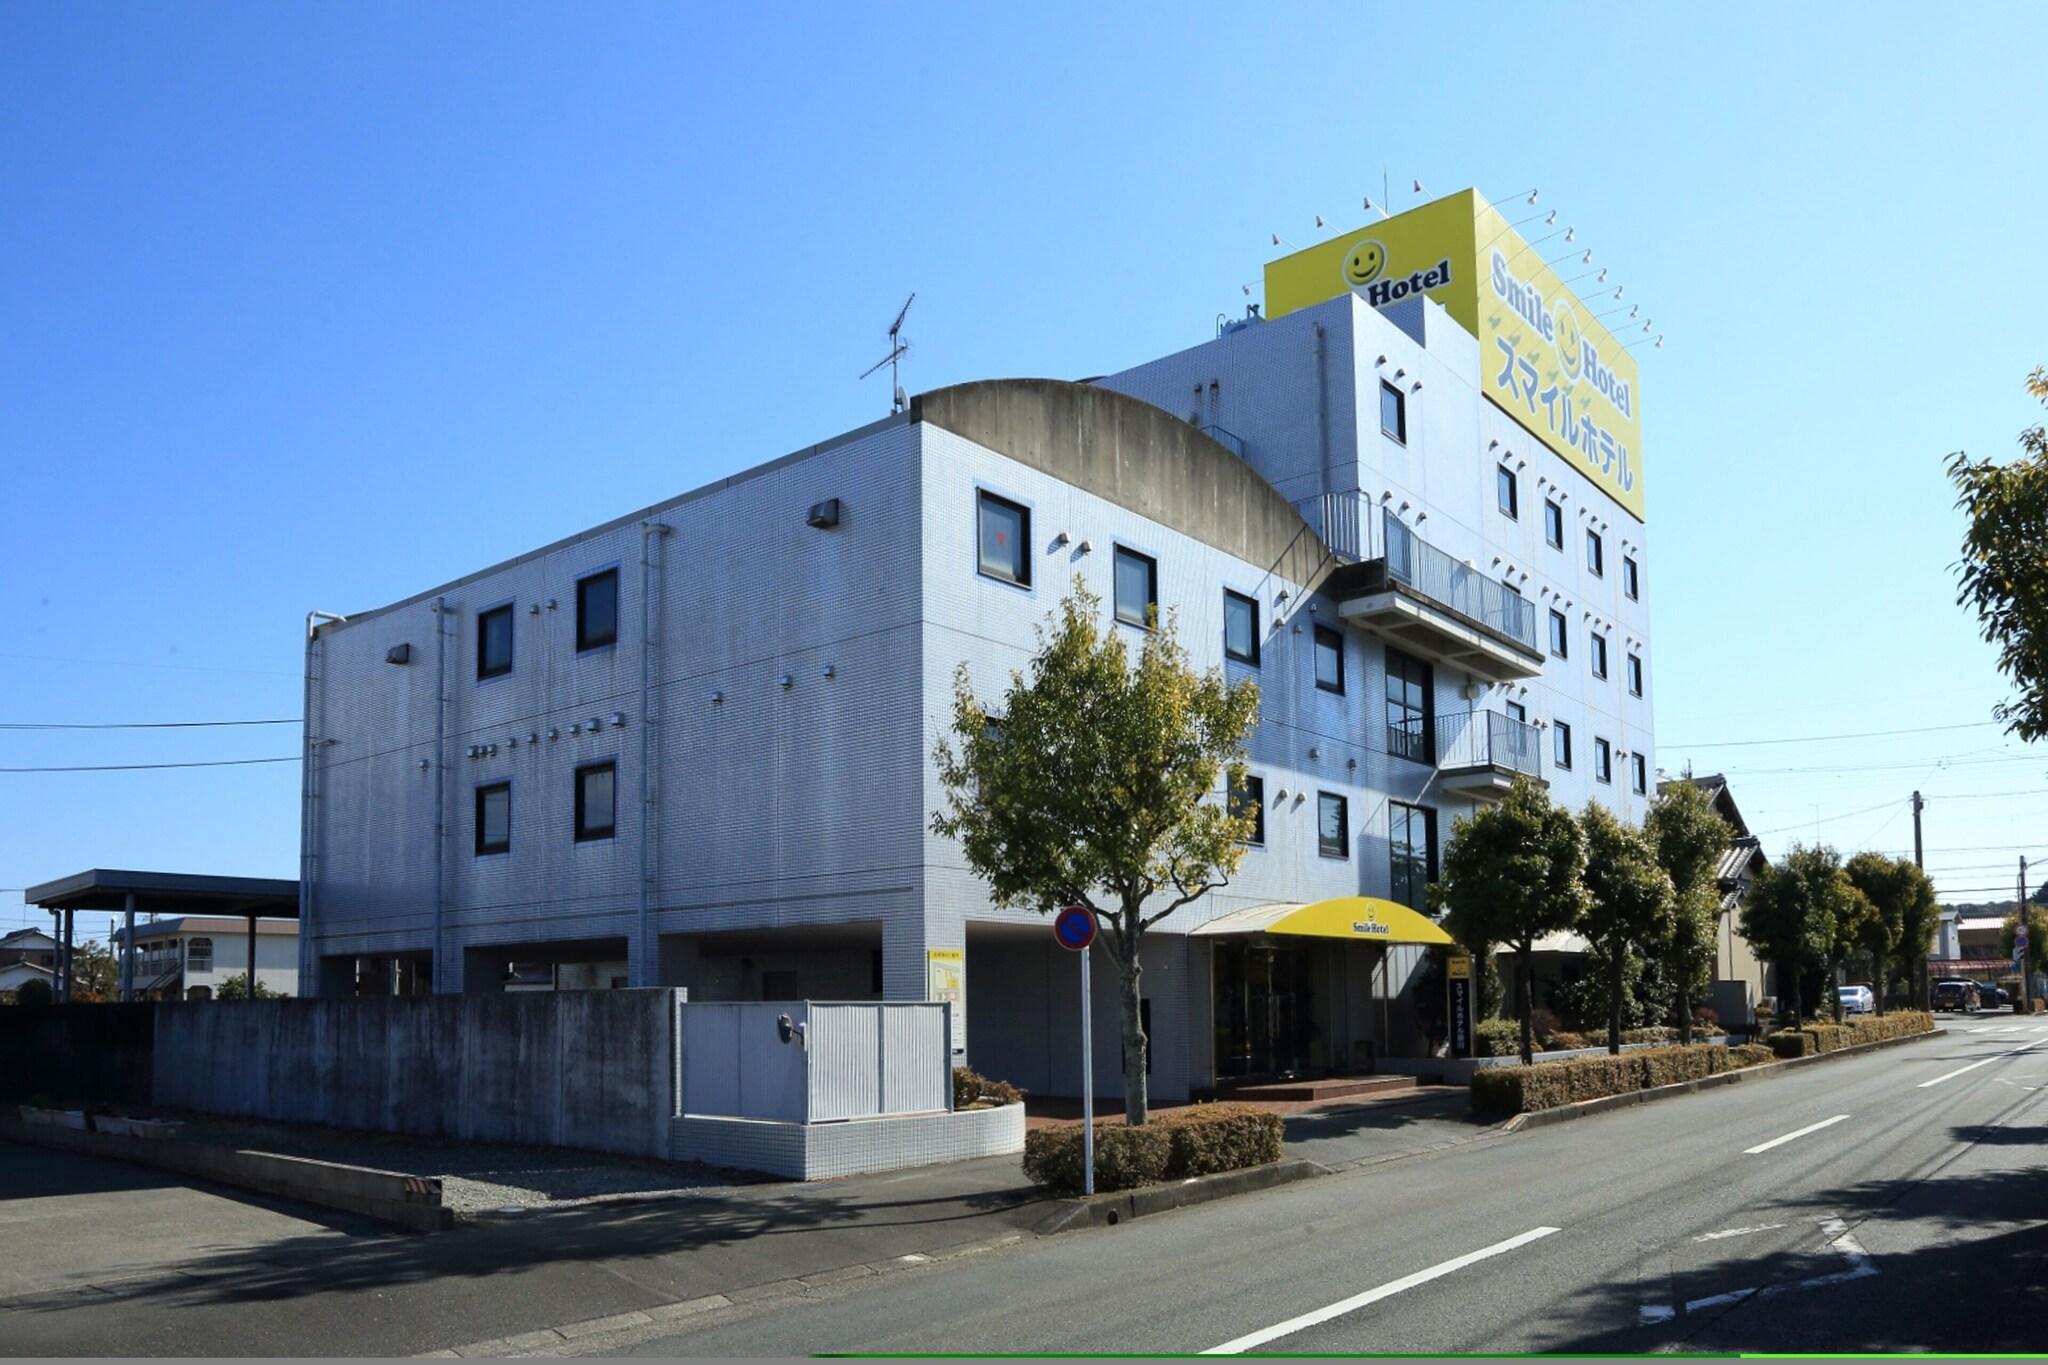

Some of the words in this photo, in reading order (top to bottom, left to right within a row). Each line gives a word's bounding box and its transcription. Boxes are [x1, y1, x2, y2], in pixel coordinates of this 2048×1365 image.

[1368, 260, 1450, 307] Hotel
[1491, 251, 1553, 341] Smile
[1583, 340, 1631, 418] Hotel
[1496, 336, 1633, 492] スマイルホテル
[1353, 921, 1370, 932] Smile
[1371, 923, 1389, 934] Hotel
